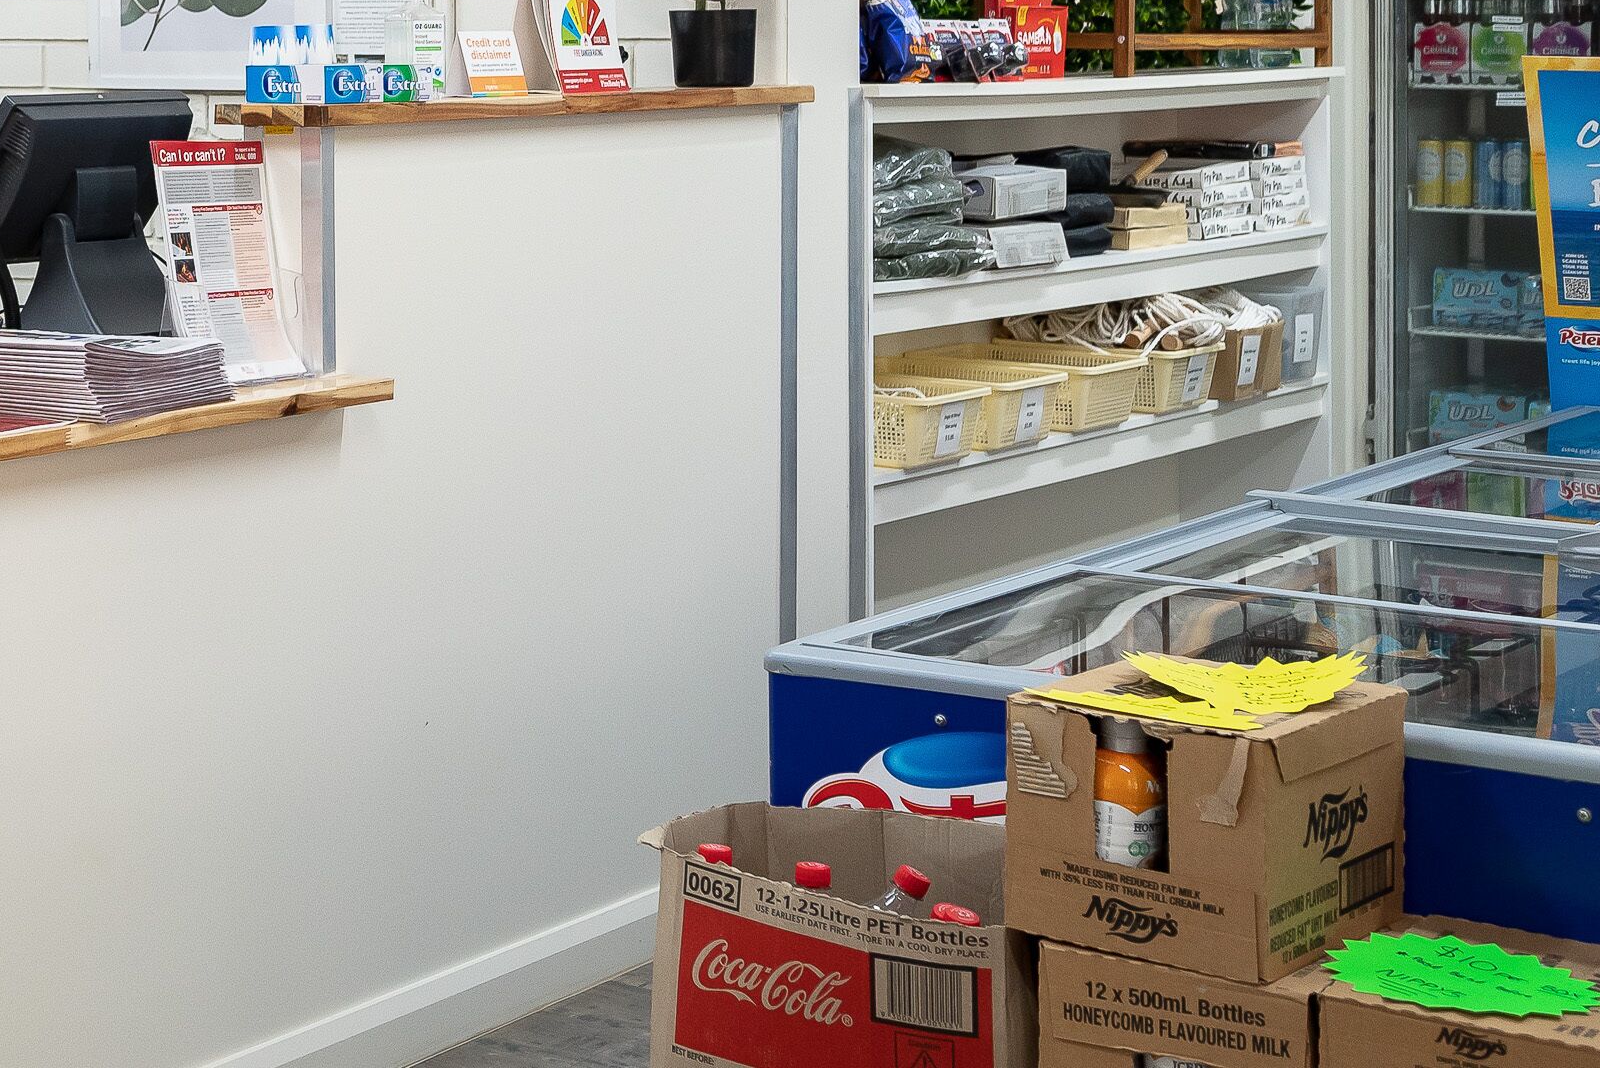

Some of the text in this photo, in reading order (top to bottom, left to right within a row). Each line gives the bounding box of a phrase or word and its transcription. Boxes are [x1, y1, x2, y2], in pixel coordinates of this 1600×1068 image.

[466, 38, 511, 47] Credit card
[471, 50, 512, 60] disclaimer
[267, 76, 302, 93] Extra
[338, 76, 375, 92] Extra
[387, 76, 425, 91] Extra
[159, 148, 226, 163] Can I or can't I?
[1204, 168, 1223, 183] Fry Pan
[1262, 163, 1270, 174] Fry
[1144, 175, 1193, 190] Fry Pan
[1264, 180, 1282, 192] Fry Pan
[1202, 190, 1224, 204] Fry Pan
[1263, 197, 1283, 211] Fry Pan
[1216, 223, 1228, 234] Pan
[1303, 785, 1368, 864] Nippy's
[688, 871, 736, 904] 0062
[1040, 867, 1225, 917] WITH 35% LESS FAT THAN FULL CREAM MILK
[1092, 867, 1118, 883] USING
[1119, 873, 1159, 891] REDUCED
[1160, 883, 1176, 895] FAT
[1178, 886, 1201, 901] MILK
[756, 887, 989, 948] 12-1.25Litre PET Bottles
[1082, 894, 1179, 944] Nippy's
[755, 904, 989, 959] USE EARLIEST DATE FIRST. STORE IN A COOL DRY PLACE.
[1434, 945, 1500, 972] $10
[1085, 981, 1266, 1027] 12 x 500mL Bottles
[1063, 1002, 1291, 1059] HONEYCOMB FLAVOURED MILK
[672, 1045, 686, 1058] BEST
[1436, 1027, 1508, 1060] Nippy's
